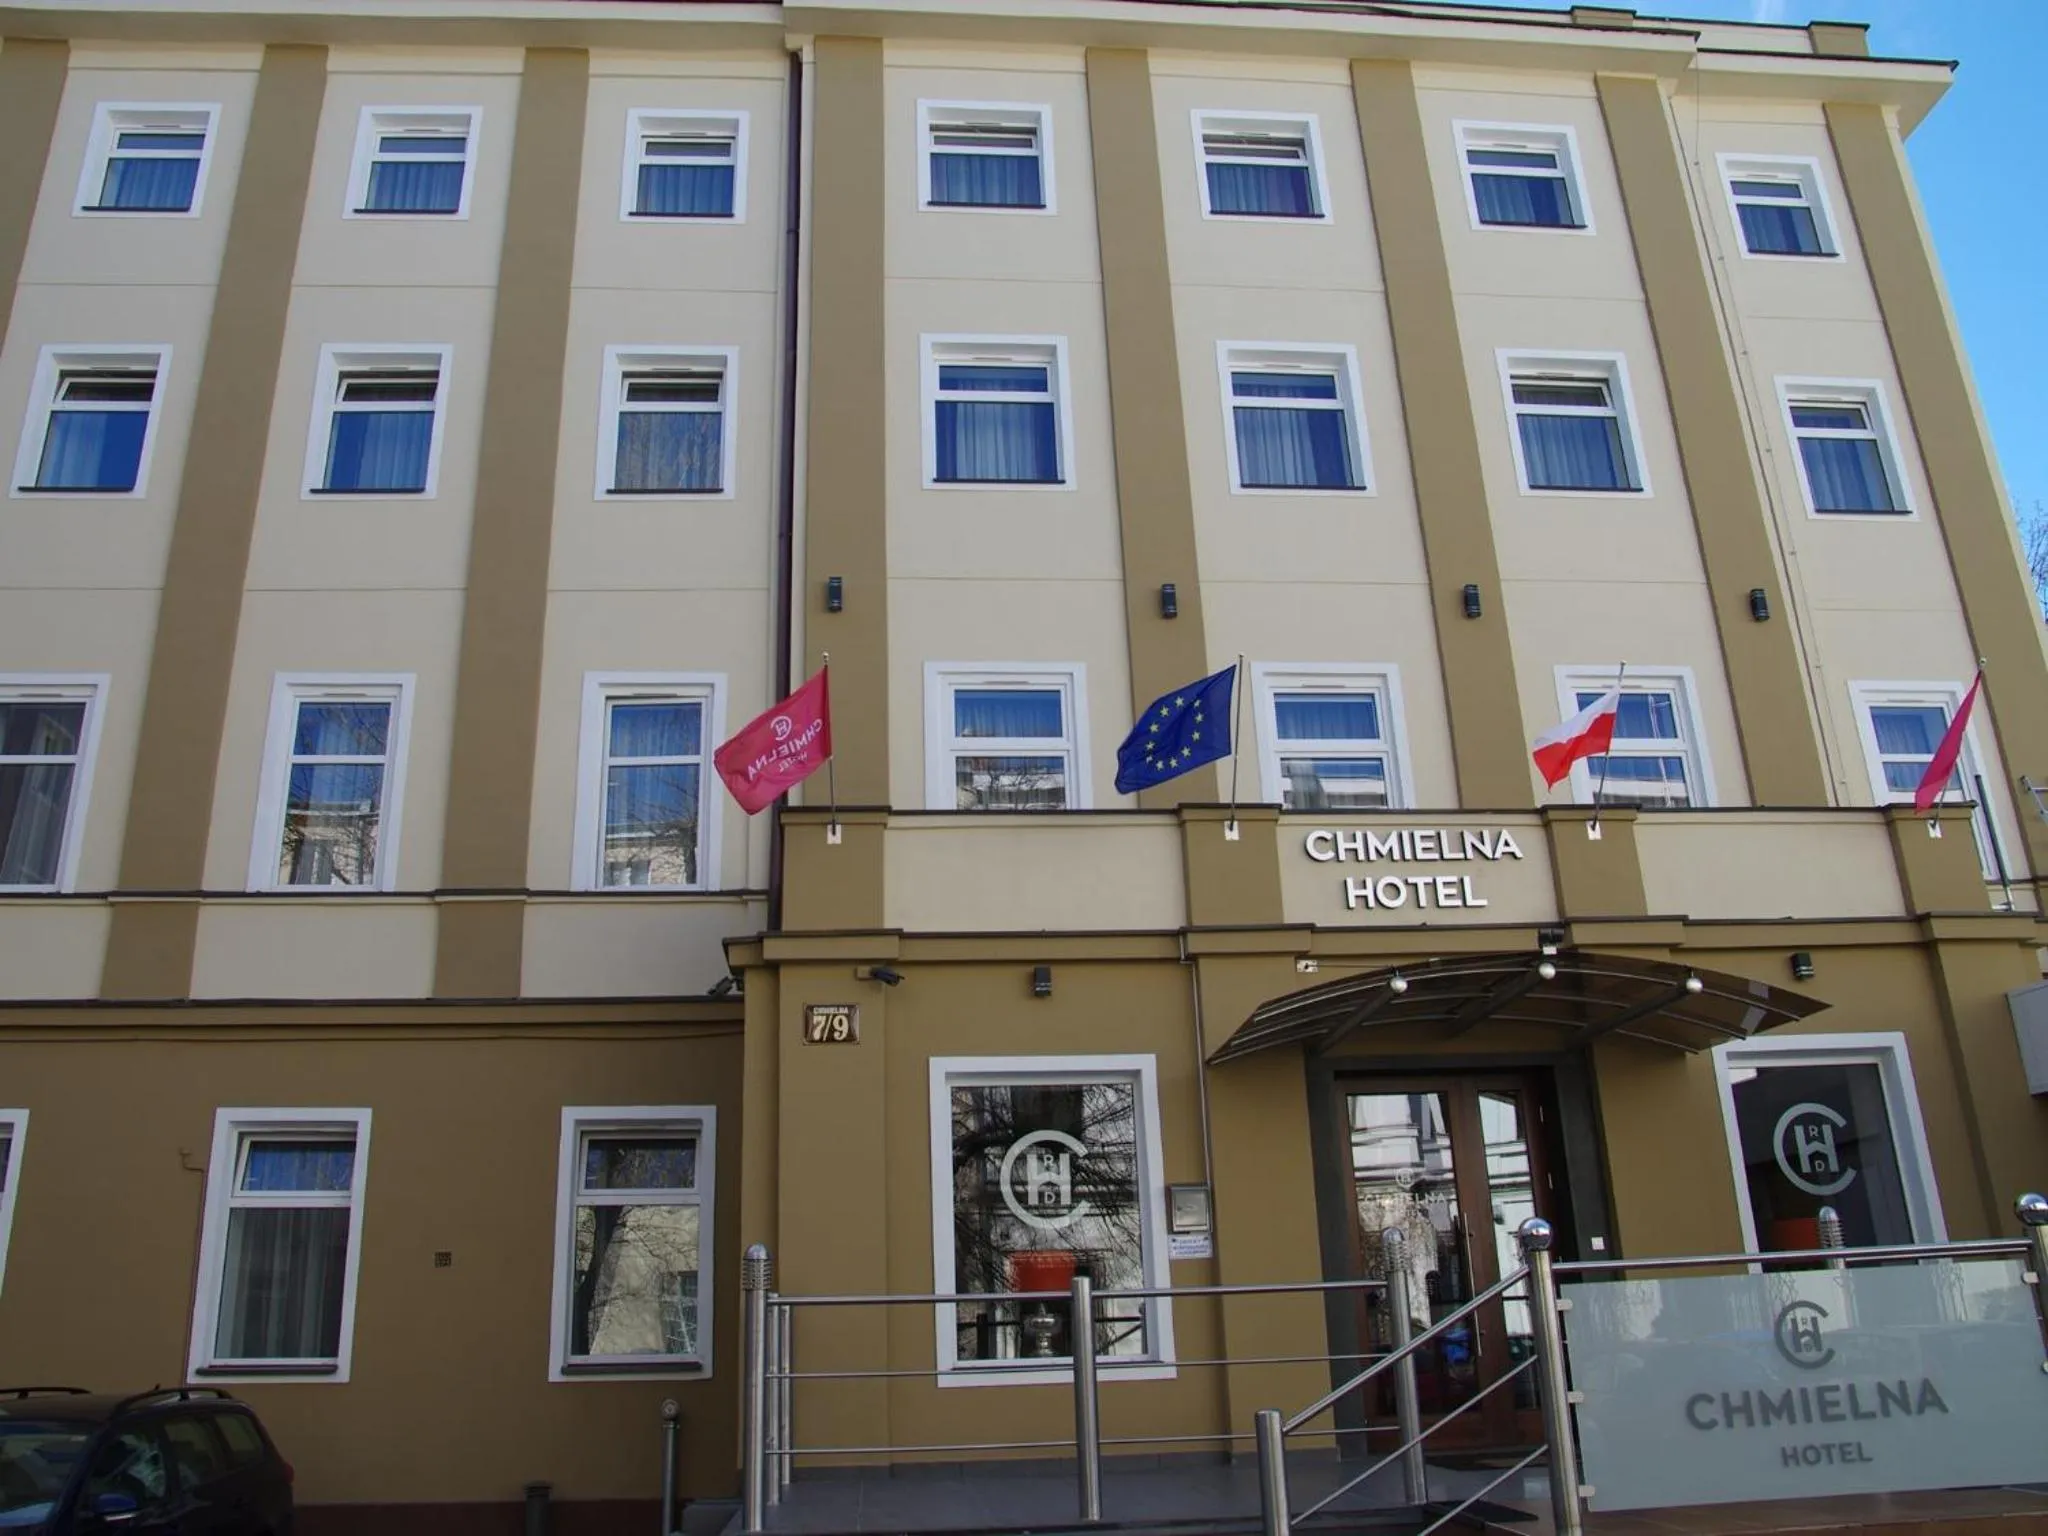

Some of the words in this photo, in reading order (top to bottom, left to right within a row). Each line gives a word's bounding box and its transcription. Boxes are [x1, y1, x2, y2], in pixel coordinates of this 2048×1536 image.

[1305, 829, 1524, 863] CHMIELNA
[1344, 876, 1488, 909] HOTEL
[812, 1014, 849, 1041] 7/9
[1364, 1192, 1447, 1205] CELNA
[1685, 1378, 1949, 1431] CHMIELNA
[1780, 1442, 1873, 1468] HOTEL
